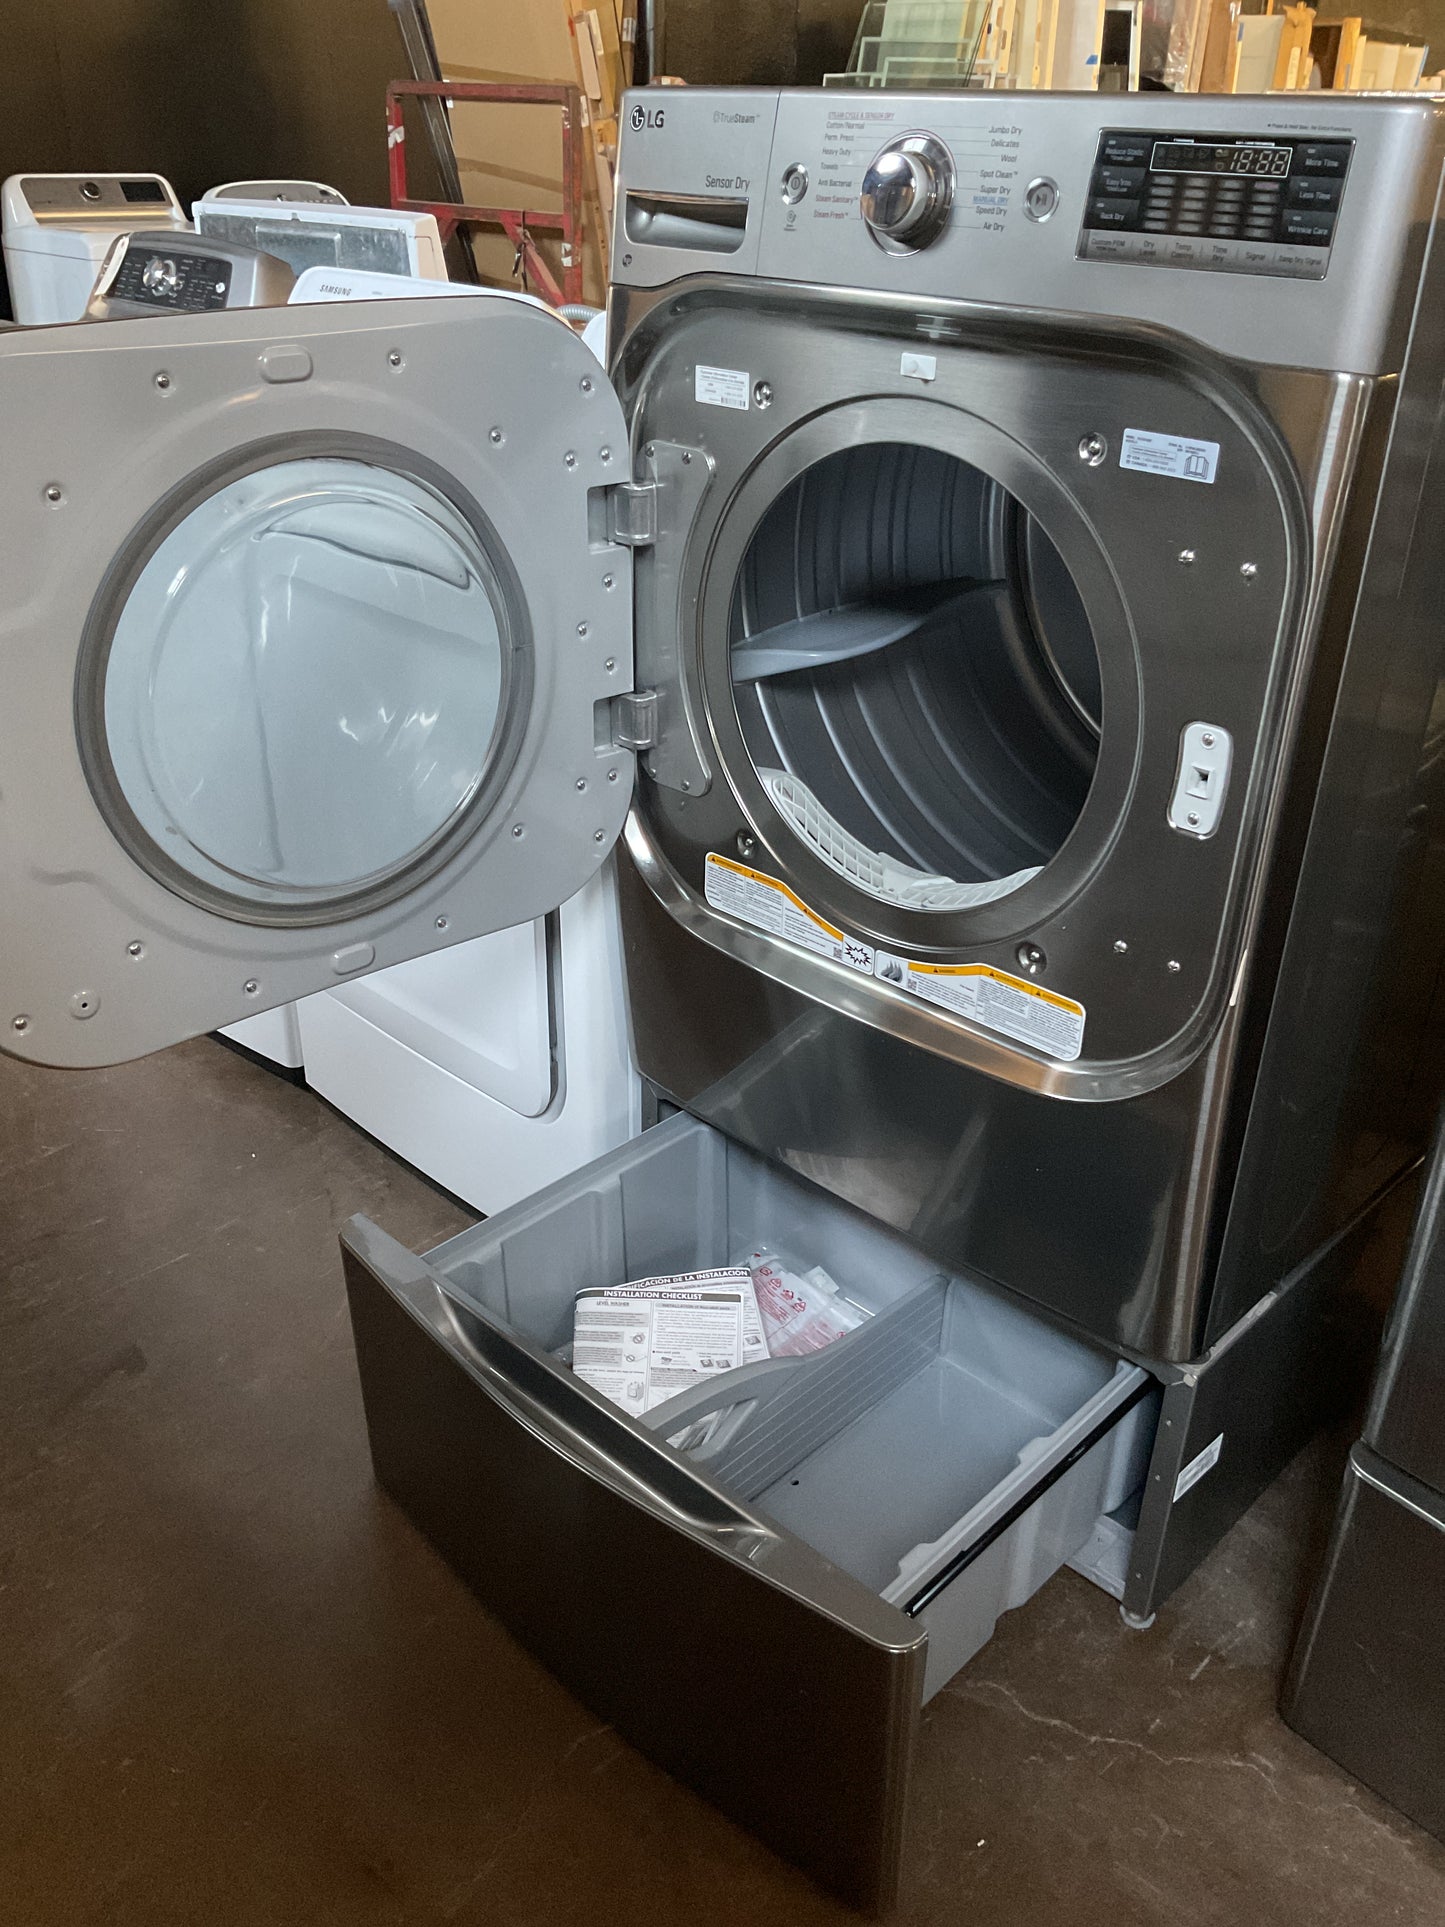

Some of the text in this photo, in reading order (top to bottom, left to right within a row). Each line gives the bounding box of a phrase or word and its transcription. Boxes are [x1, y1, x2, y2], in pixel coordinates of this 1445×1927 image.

[1011, 126, 1022, 135] Dry
[991, 139, 1020, 147] Delicates
[822, 148, 851, 156] Heavy Duty
[980, 170, 994, 178] Spot
[705, 175, 750, 192] Sensor Dry
[980, 185, 1010, 195] Super Dry
[976, 206, 1007, 216] Speed Dry
[1115, 213, 1125, 221] Dry
[993, 222, 1005, 232] Dry
[1313, 227, 1328, 236] Care
[1144, 240, 1154, 249] Dry
[1213, 246, 1228, 254] Time
[1246, 252, 1265, 262] Signal
[320, 285, 352, 296] SAMSUNG
